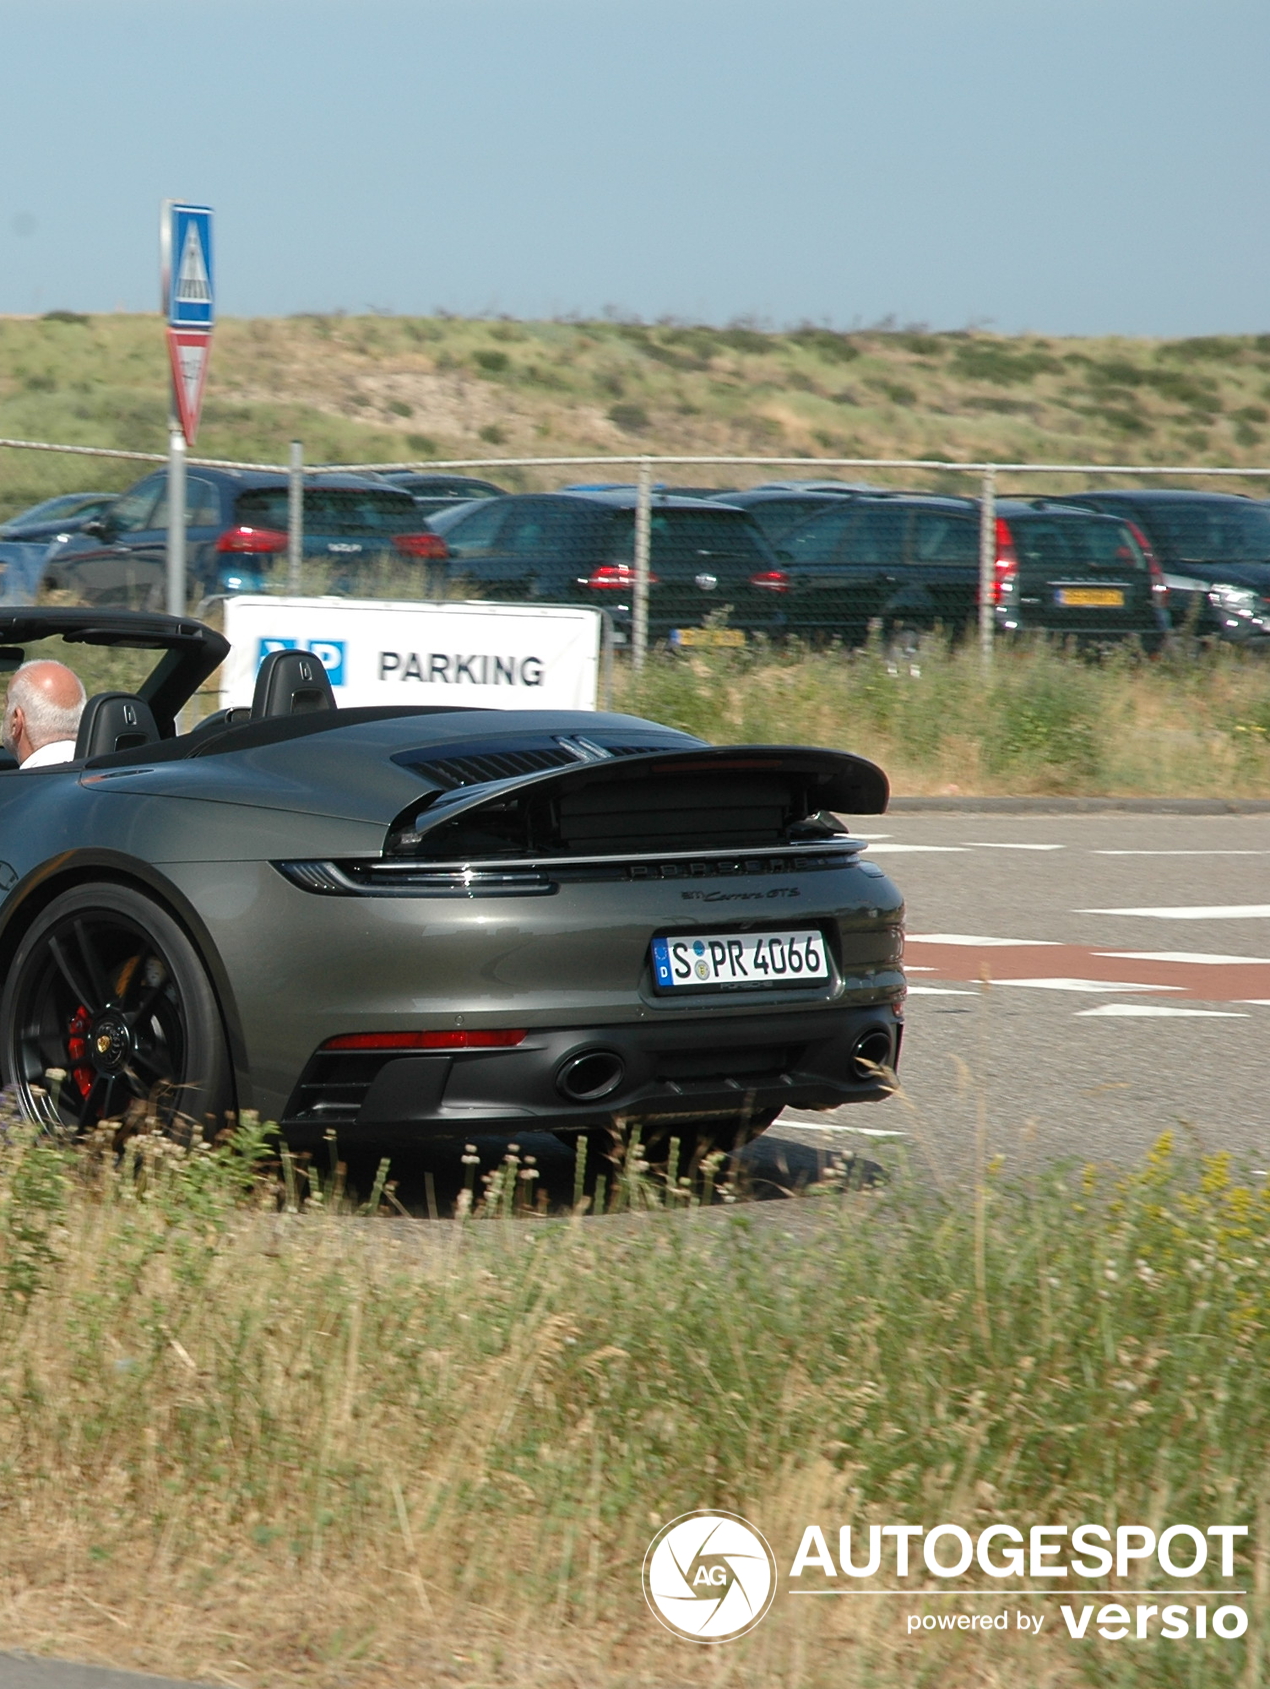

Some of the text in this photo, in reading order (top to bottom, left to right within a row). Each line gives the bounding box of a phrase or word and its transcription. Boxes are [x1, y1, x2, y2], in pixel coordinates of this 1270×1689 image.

[378, 651, 545, 687] PARKING
[631, 858, 807, 877] PORSCHE
[766, 887, 801, 898] GTS
[673, 936, 820, 978] S PR 4066
[660, 966, 668, 978] D
[720, 981, 773, 989] PORSCHE
